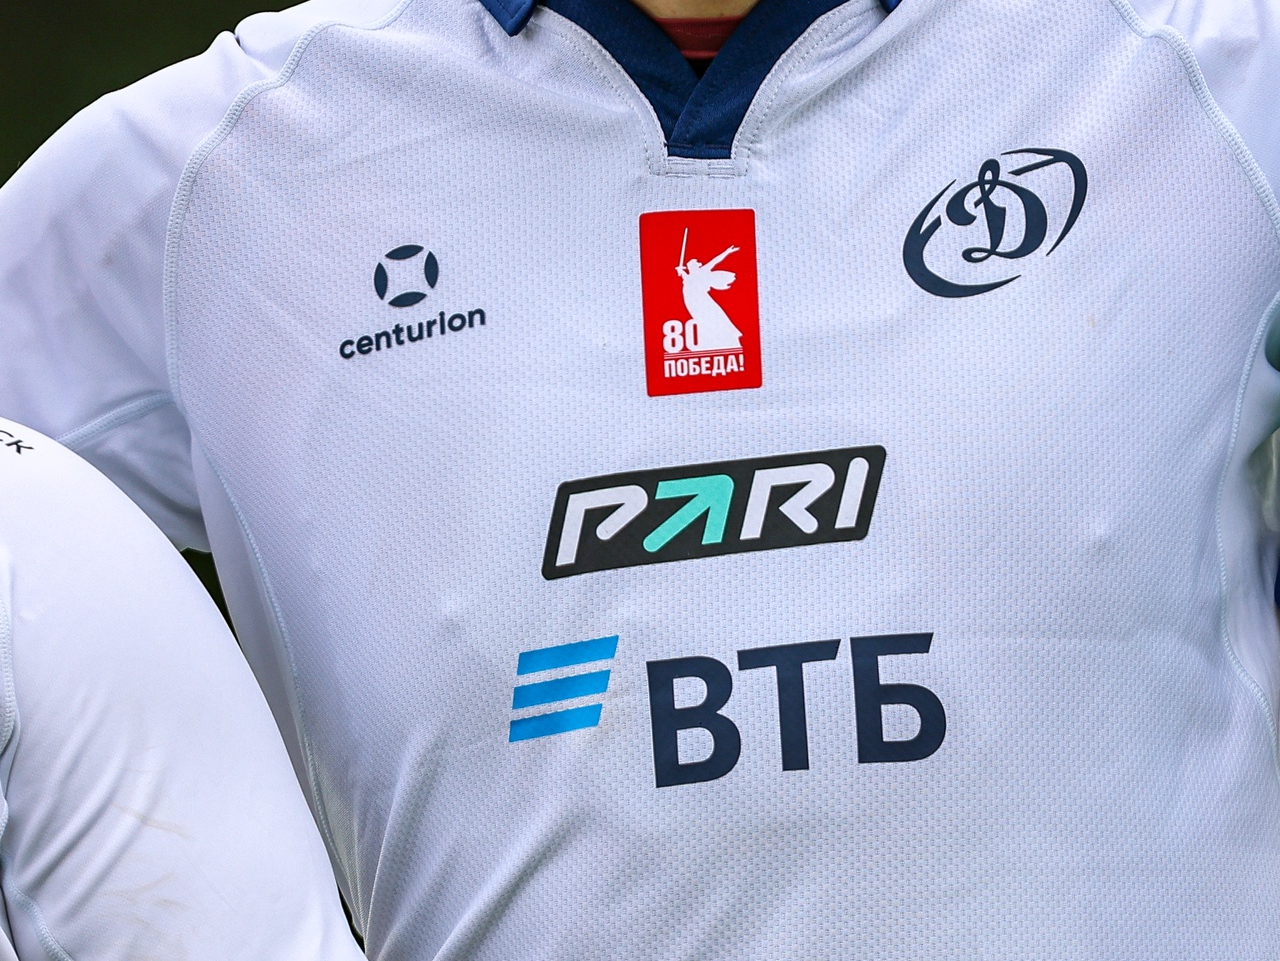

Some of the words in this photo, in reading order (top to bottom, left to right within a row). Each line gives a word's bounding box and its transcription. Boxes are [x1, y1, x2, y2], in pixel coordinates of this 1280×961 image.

[339, 308, 486, 360] centurion
[662, 318, 700, 354] 80
[663, 353, 745, 379] ПОБЕДА!
[555, 456, 870, 567] PARI
[645, 632, 948, 788] ВТБ
